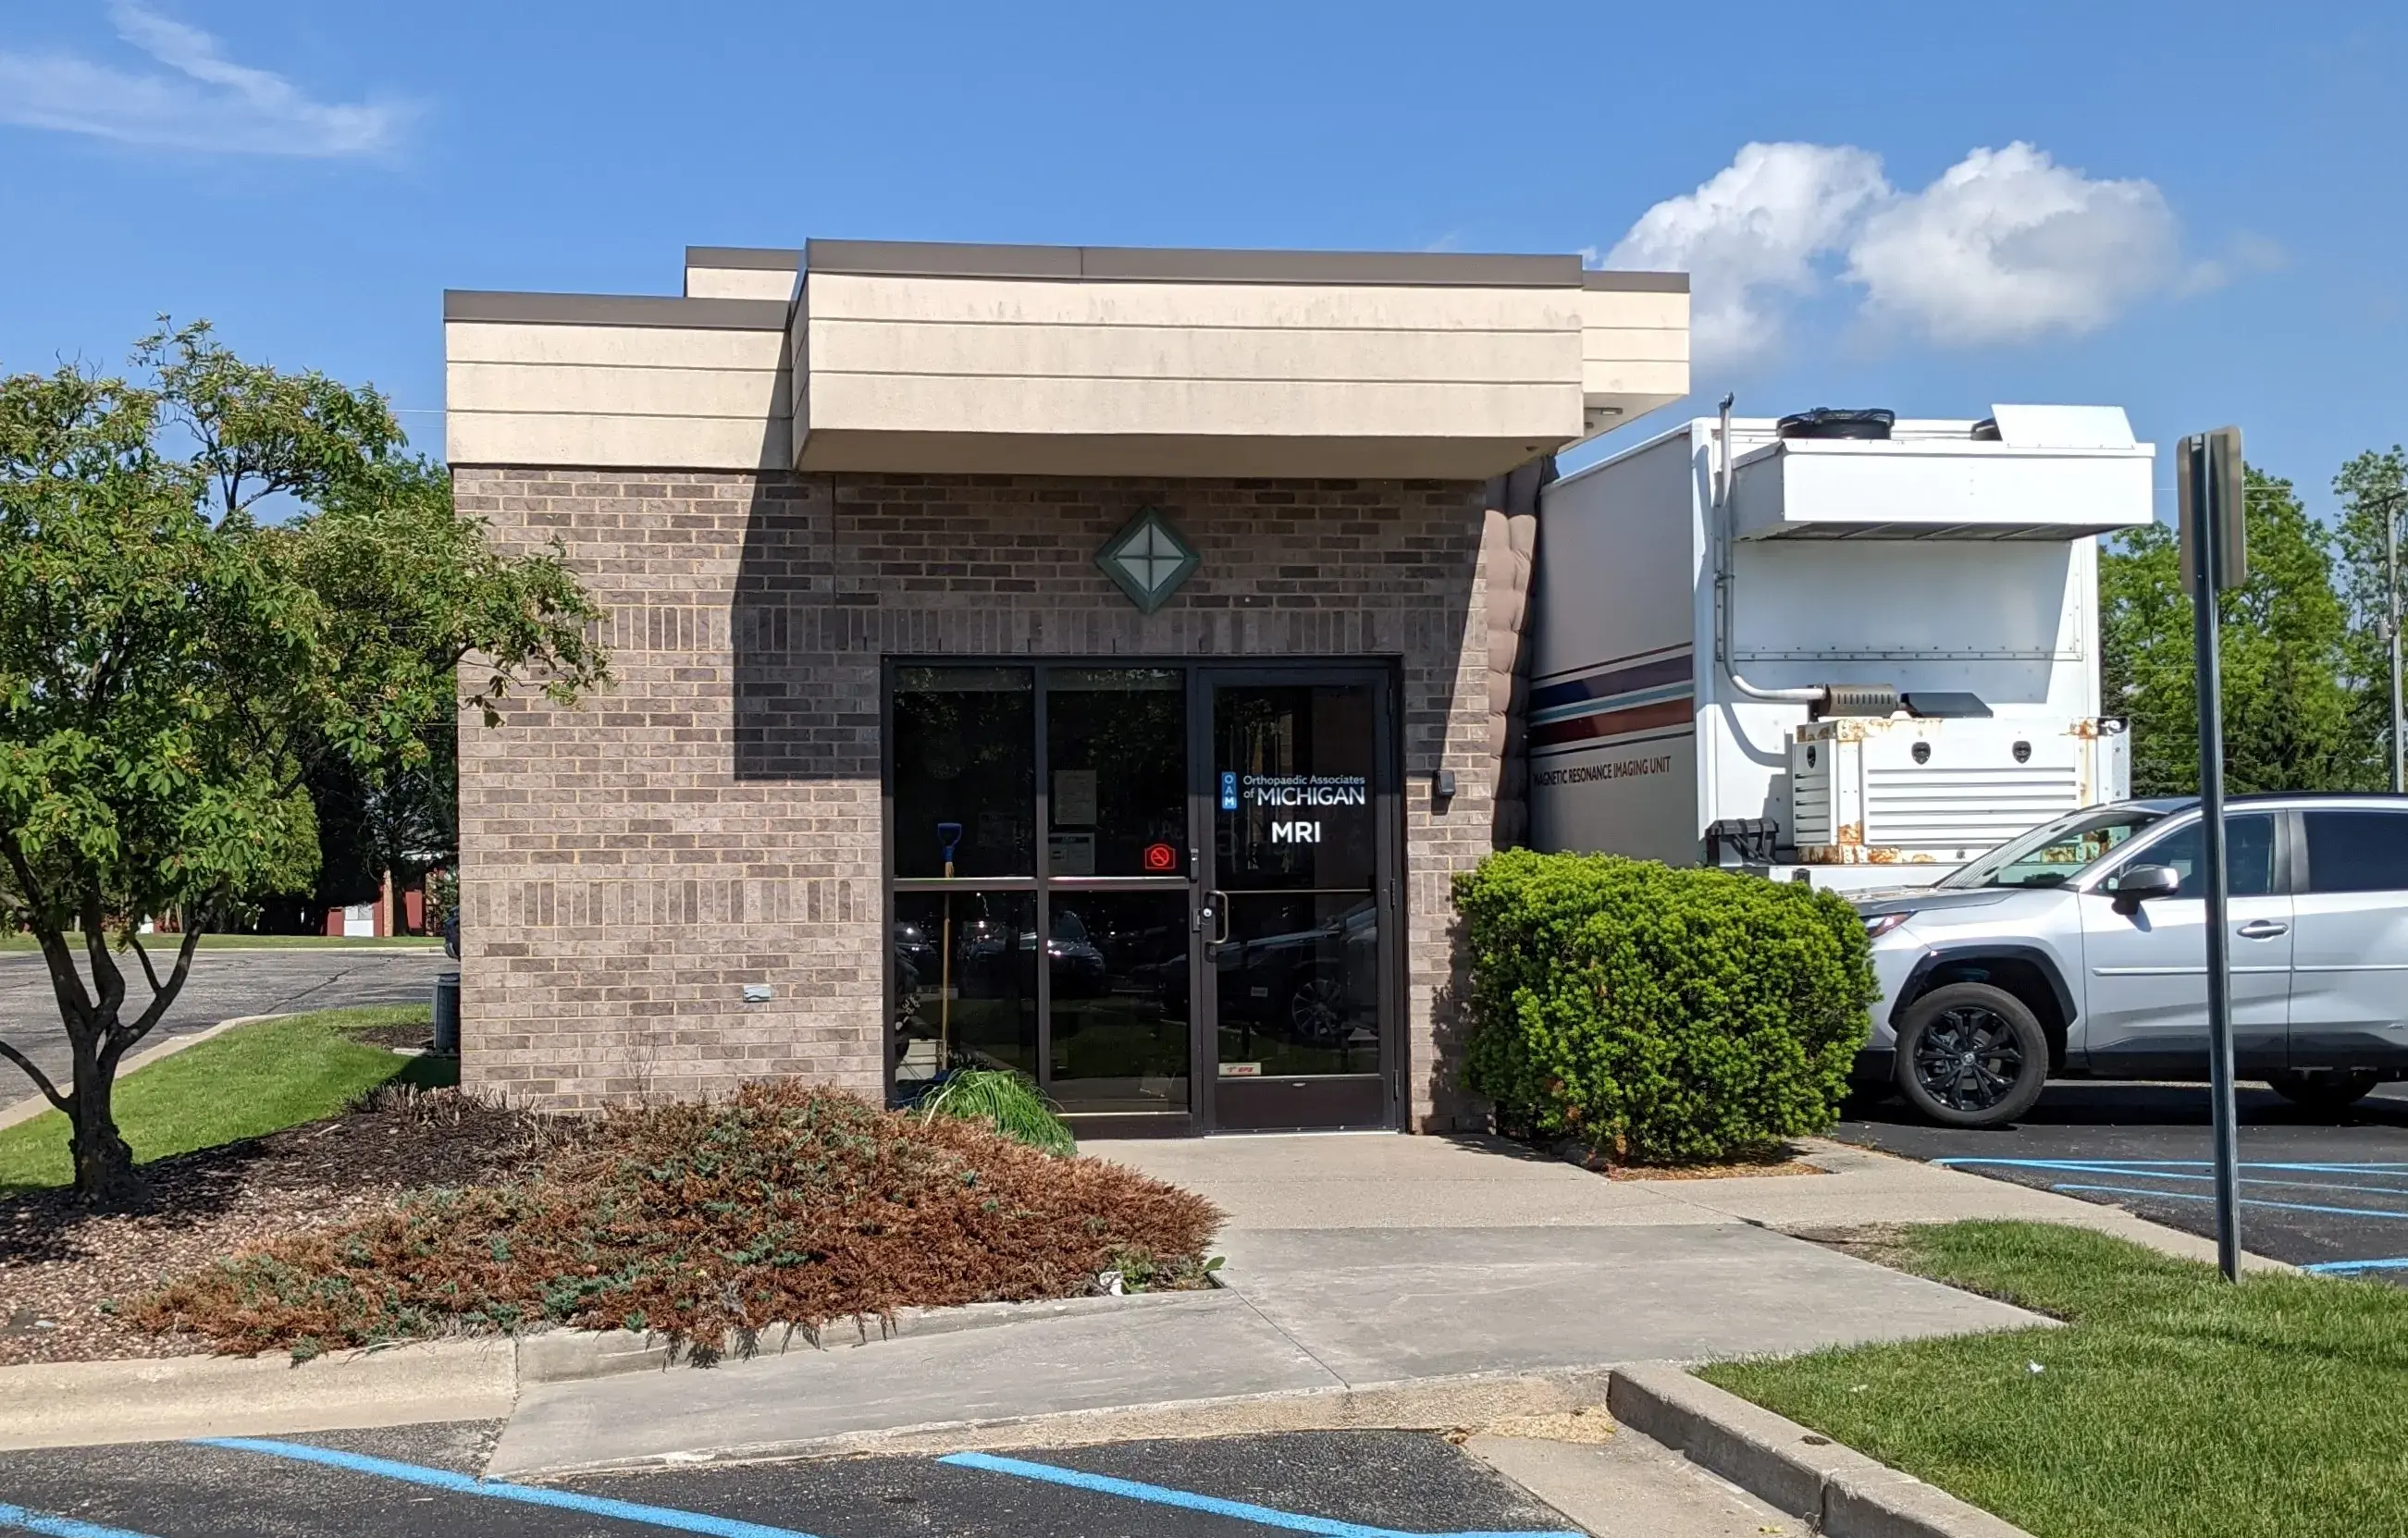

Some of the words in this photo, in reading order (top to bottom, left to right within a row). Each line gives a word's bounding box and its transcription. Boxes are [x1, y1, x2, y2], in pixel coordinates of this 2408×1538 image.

[1243, 775, 1307, 786] Orthopaedic
[1309, 775, 1365, 784] Associates
[1569, 764, 1612, 783] RESONANCE
[1613, 758, 1649, 778] IMAGING
[1650, 756, 1671, 773] UNIT
[1224, 775, 1235, 806] OAM
[1243, 787, 1254, 798] of
[1257, 787, 1365, 806] MICHIGAN
[1272, 821, 1321, 843] MRI
